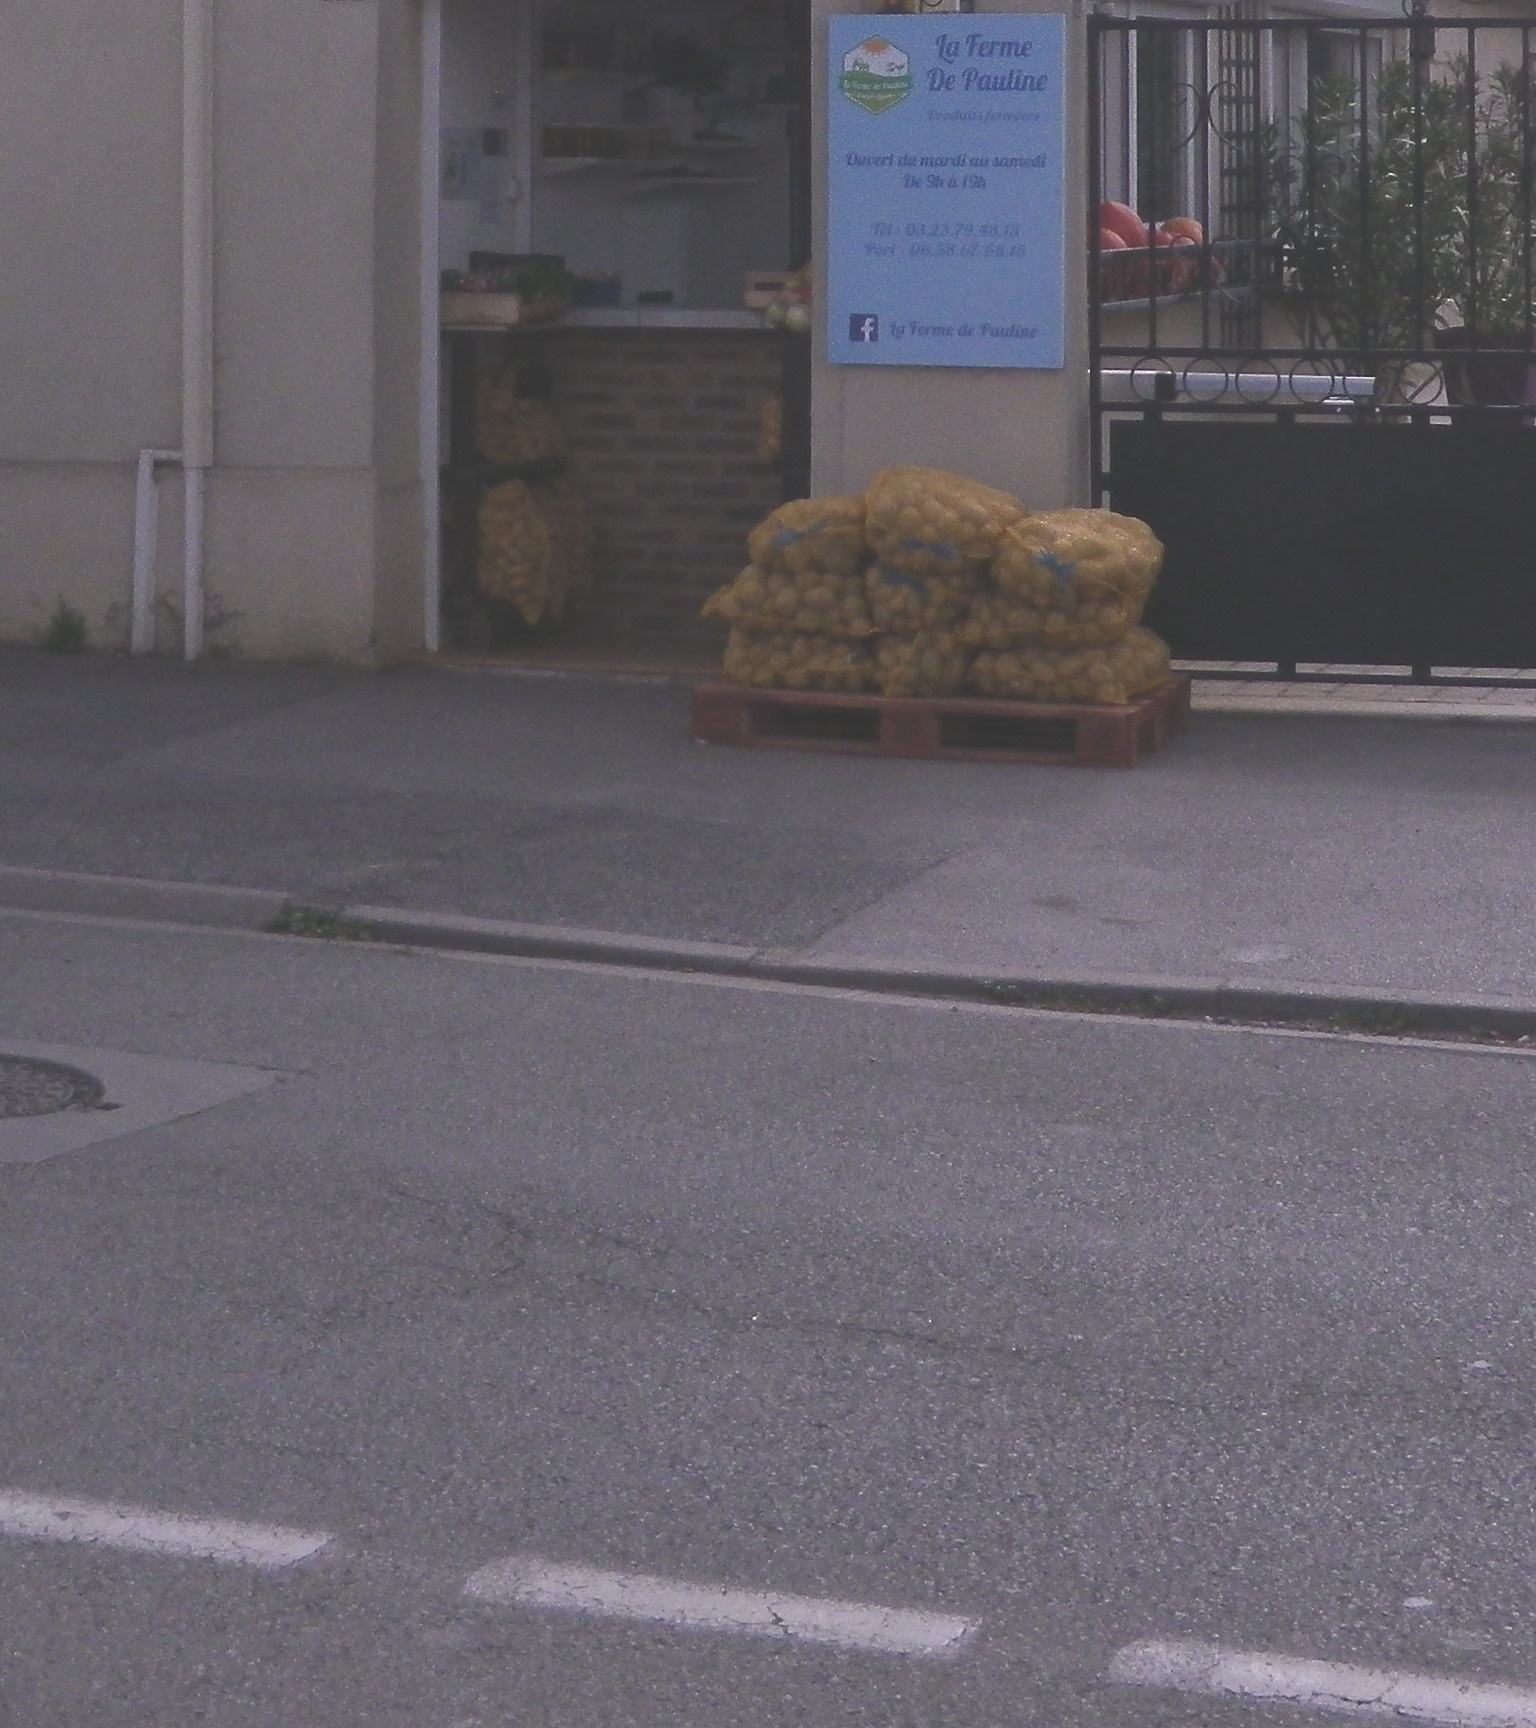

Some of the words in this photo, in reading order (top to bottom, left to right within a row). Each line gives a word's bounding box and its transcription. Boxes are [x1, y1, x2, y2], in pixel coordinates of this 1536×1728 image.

[935, 33, 960, 65] La
[965, 33, 1033, 58] Ferme
[927, 67, 956, 91] De
[961, 67, 1049, 92] Pauline
[845, 151, 894, 167] Ouvert
[898, 153, 917, 167] du
[920, 153, 967, 168] mardi
[969, 156, 989, 168] au
[992, 153, 1047, 168] samedi
[902, 174, 922, 189] De
[957, 322, 975, 337] de
